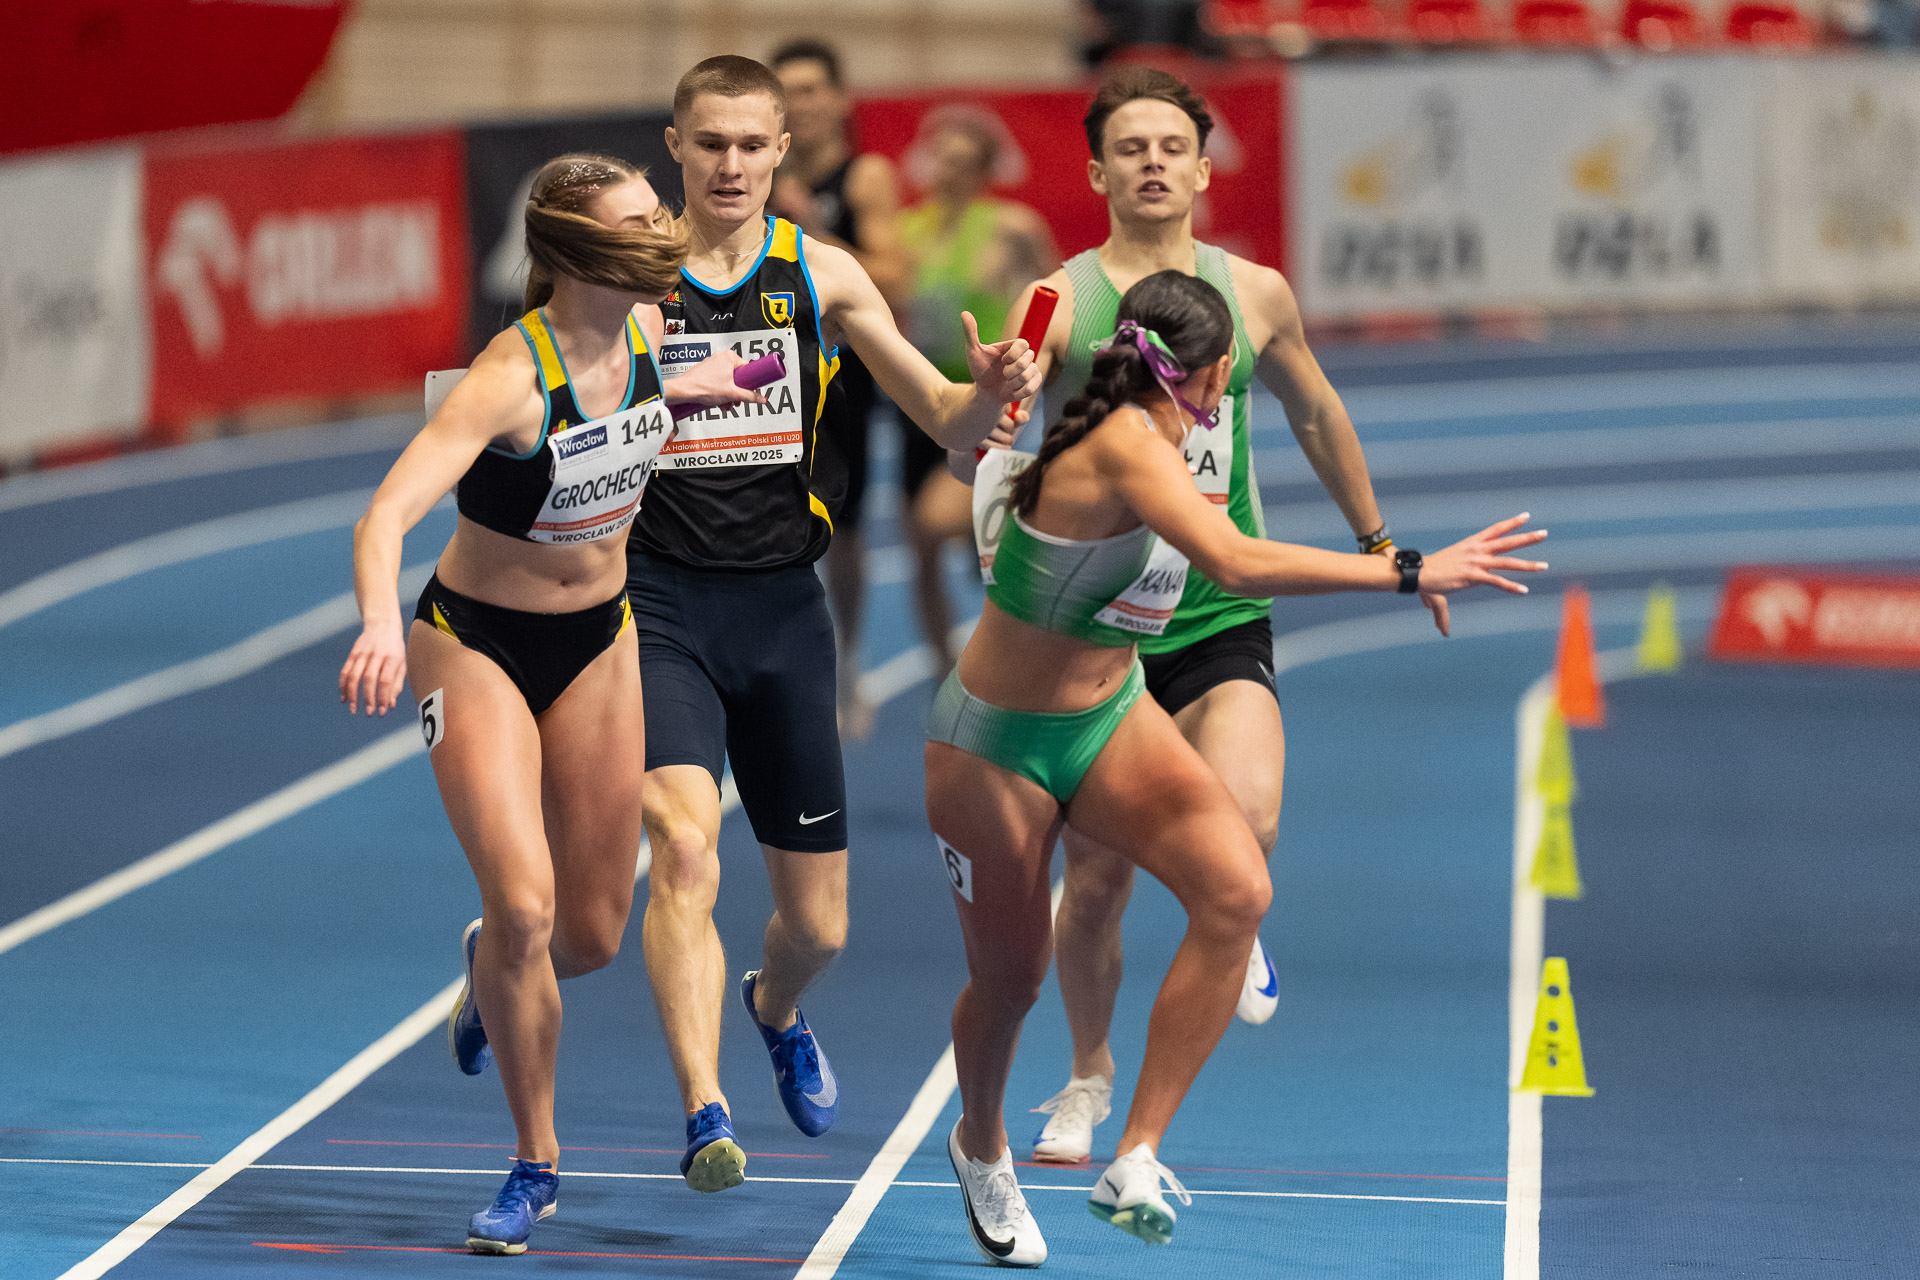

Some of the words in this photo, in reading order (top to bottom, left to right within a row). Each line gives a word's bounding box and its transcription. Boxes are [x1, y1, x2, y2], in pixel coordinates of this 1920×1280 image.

[621, 409, 664, 445] 144
[672, 443, 700, 452] Halowe
[701, 439, 747, 449] Mistrzostwa
[747, 436, 769, 445] Polski
[770, 435, 783, 443] U18
[786, 434, 801, 442] U20
[673, 452, 749, 468] WROCŁAW
[751, 448, 784, 462] 2025
[551, 456, 656, 510] GROCHECK
[552, 523, 615, 542] WROCŁAW
[421, 696, 436, 748] 5
[944, 846, 963, 889] 6
